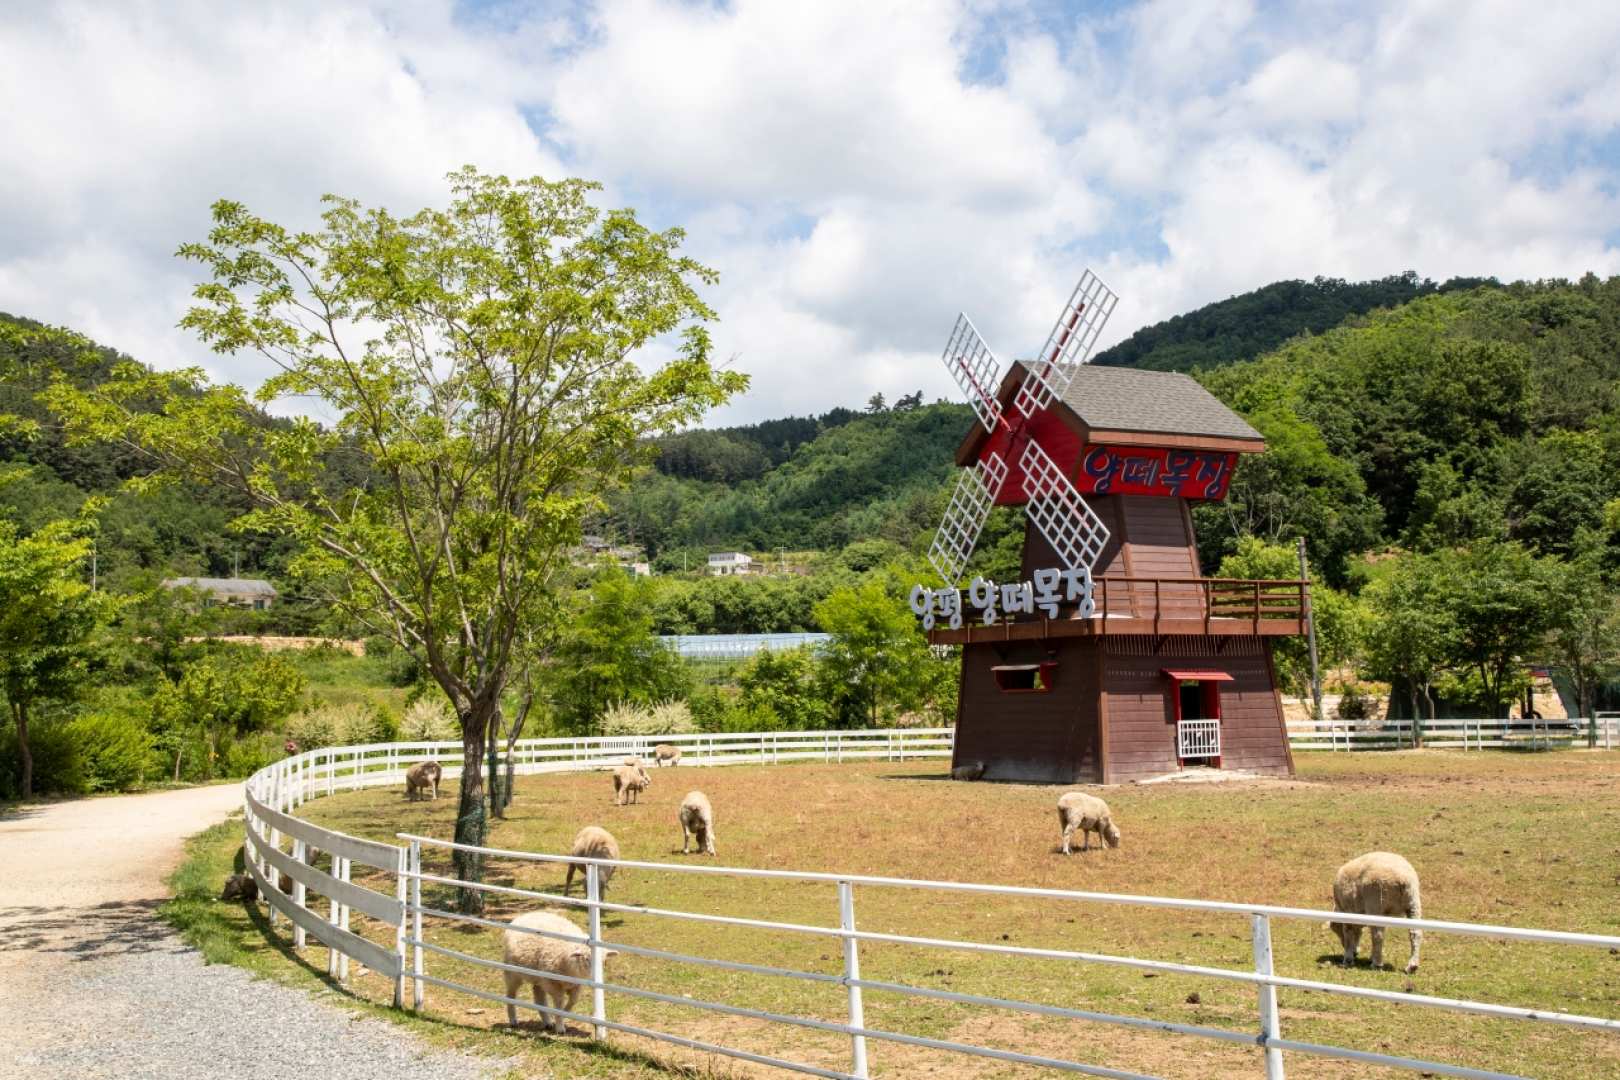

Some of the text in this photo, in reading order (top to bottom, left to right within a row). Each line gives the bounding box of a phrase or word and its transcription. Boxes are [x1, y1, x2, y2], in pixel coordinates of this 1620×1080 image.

[1084, 447, 1231, 497] 양떼목장
[909, 566, 1096, 631] 양평 양떼목장
